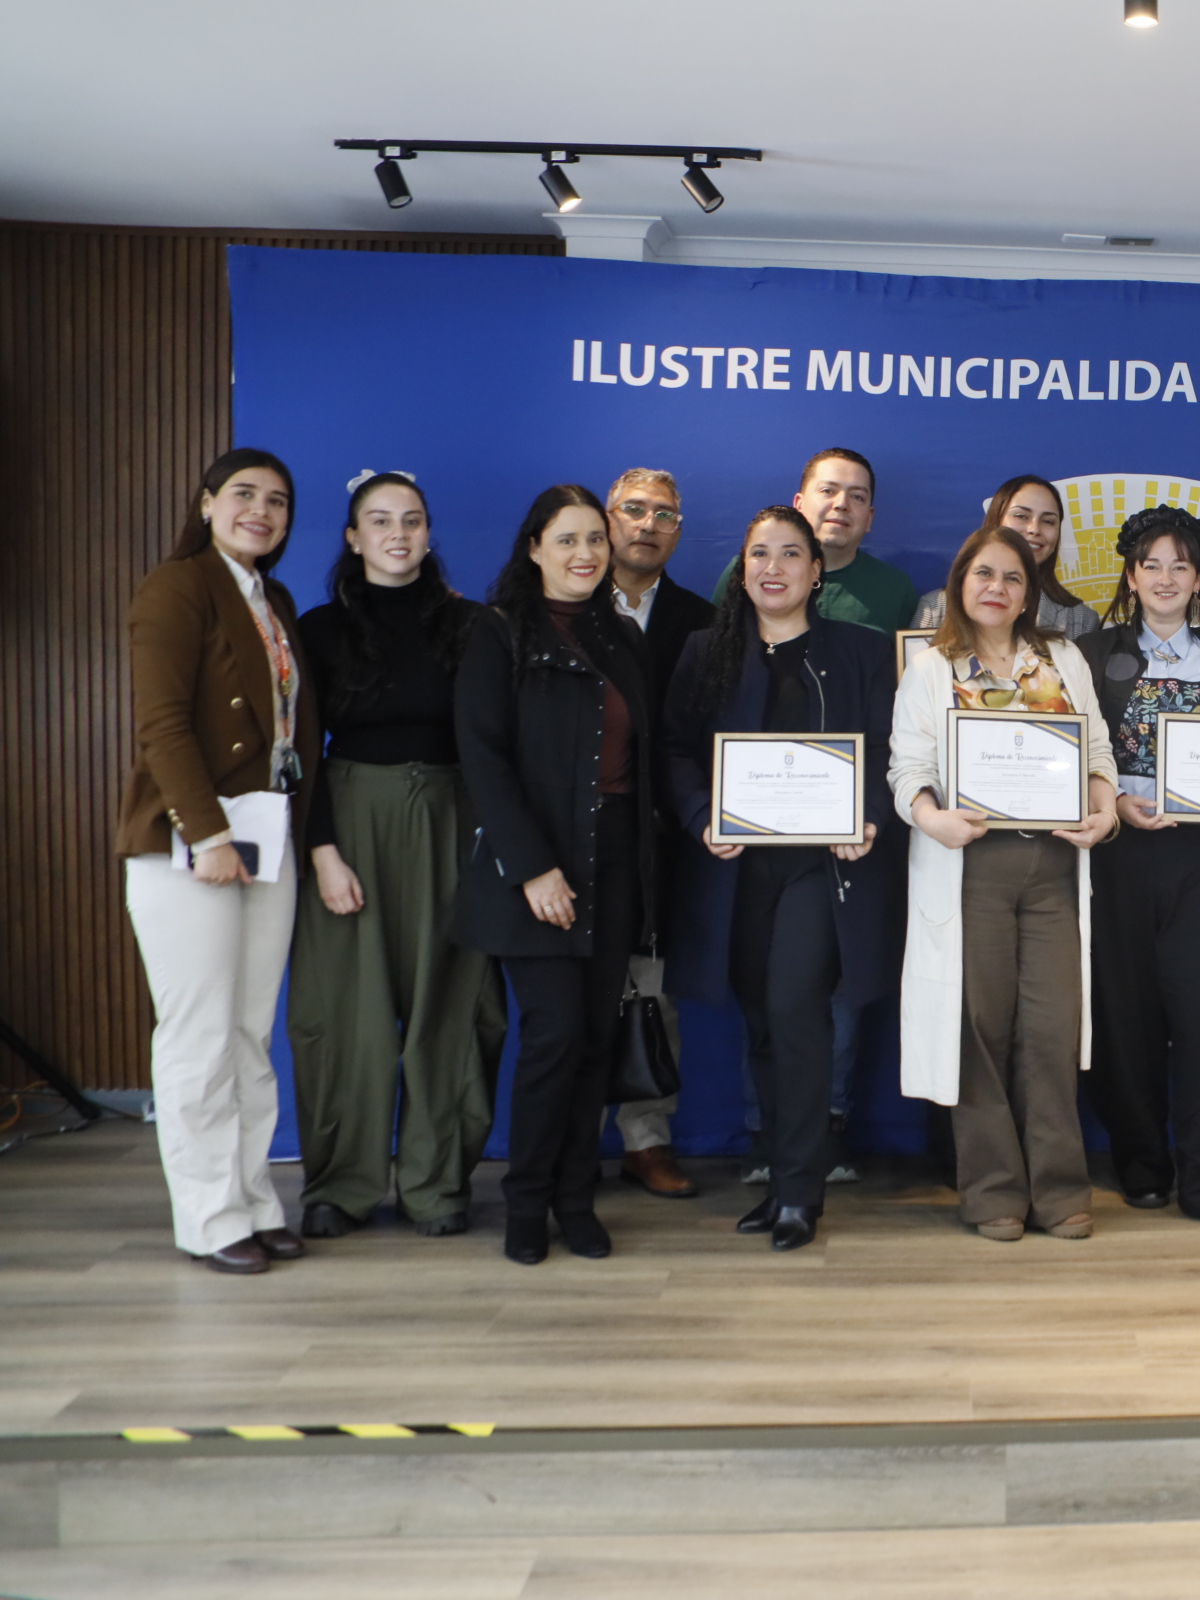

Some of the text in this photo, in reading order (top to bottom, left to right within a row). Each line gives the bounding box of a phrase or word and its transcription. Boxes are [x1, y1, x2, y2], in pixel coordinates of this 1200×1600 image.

[572, 339, 791, 391] ILUSTRE
[980, 752, 1006, 761] Diploma
[1006, 752, 1013, 760] de
